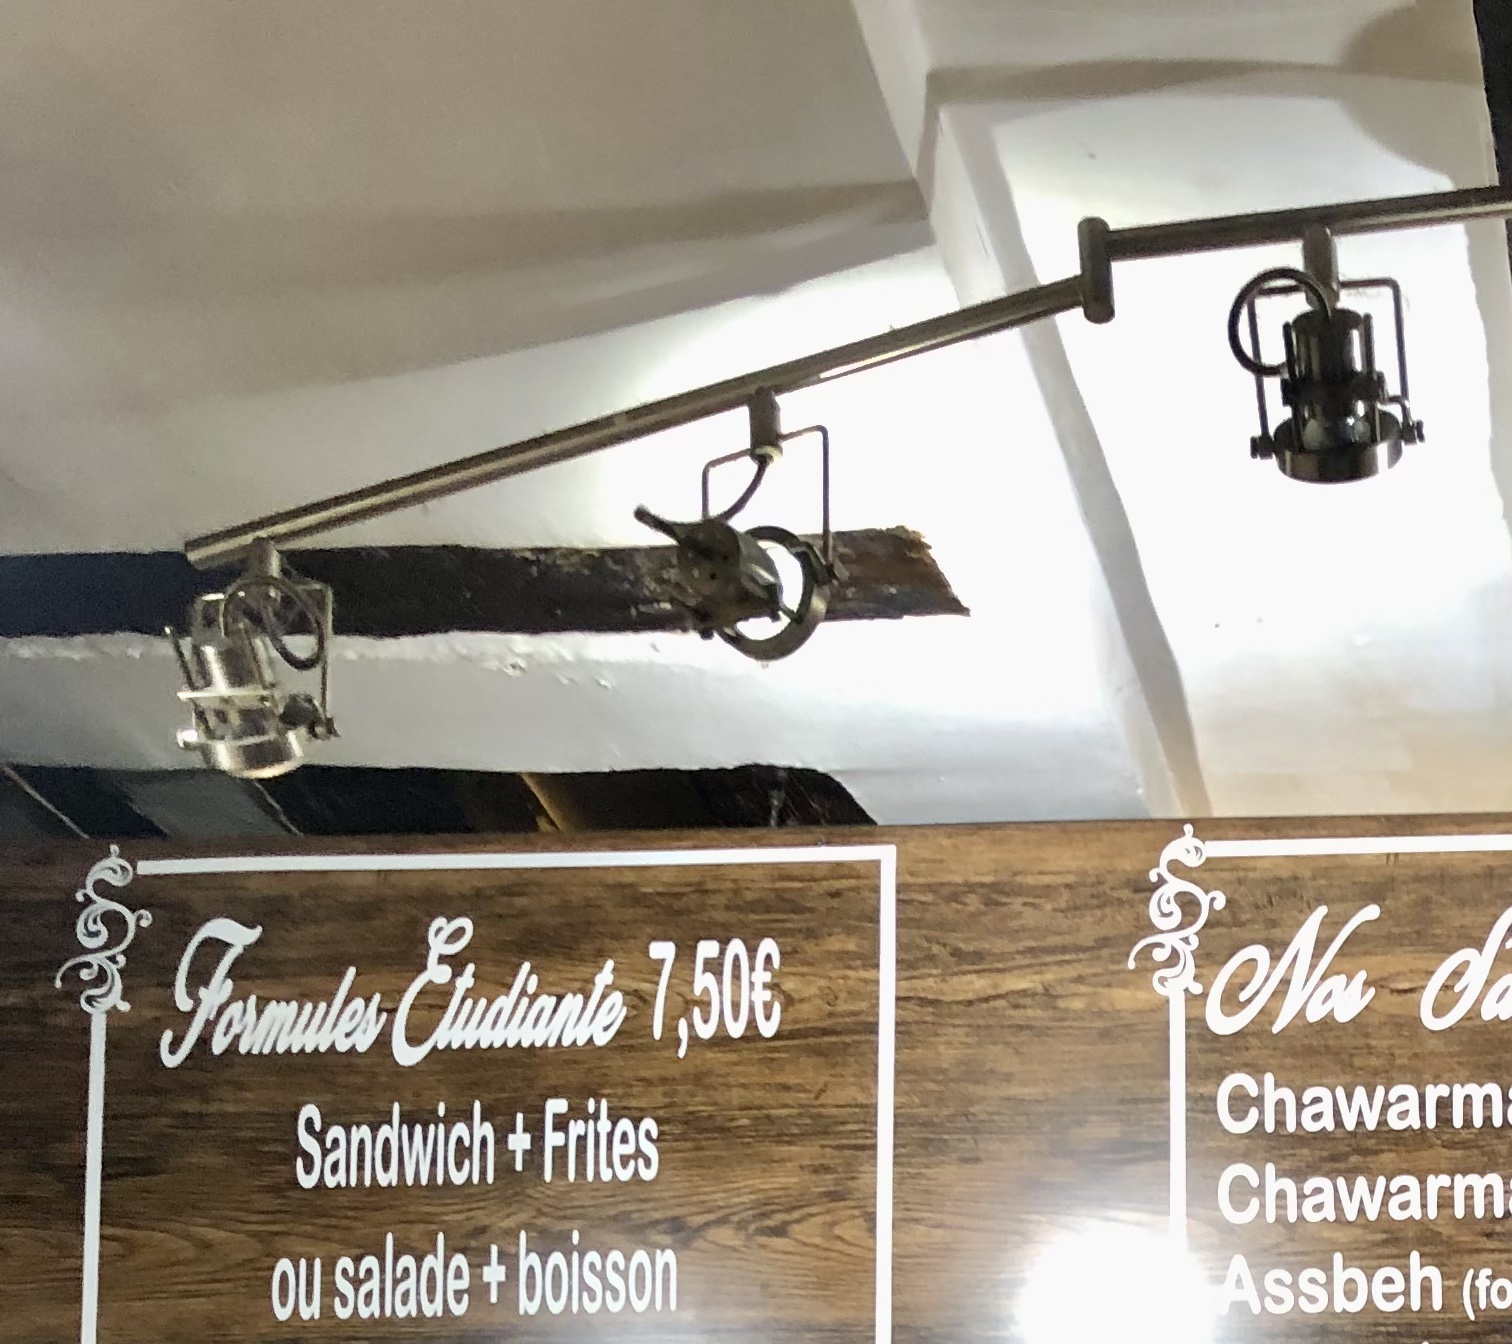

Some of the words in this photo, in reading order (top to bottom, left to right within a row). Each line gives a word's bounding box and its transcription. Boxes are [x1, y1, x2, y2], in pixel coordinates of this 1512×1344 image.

[160, 917, 385, 1069] Formules
[392, 917, 627, 1066] Etudiante
[649, 938, 780, 1058] 7,50€
[1205, 904, 1381, 1036] Nos
[296, 1100, 494, 1188] Sandwich
[508, 1113, 531, 1171] +
[544, 1098, 658, 1182] Frites
[272, 1258, 321, 1320] ou
[334, 1232, 470, 1319] salade
[483, 1245, 505, 1303] +
[518, 1231, 678, 1315] boisson
[1217, 1252, 1443, 1316] Assbeh
